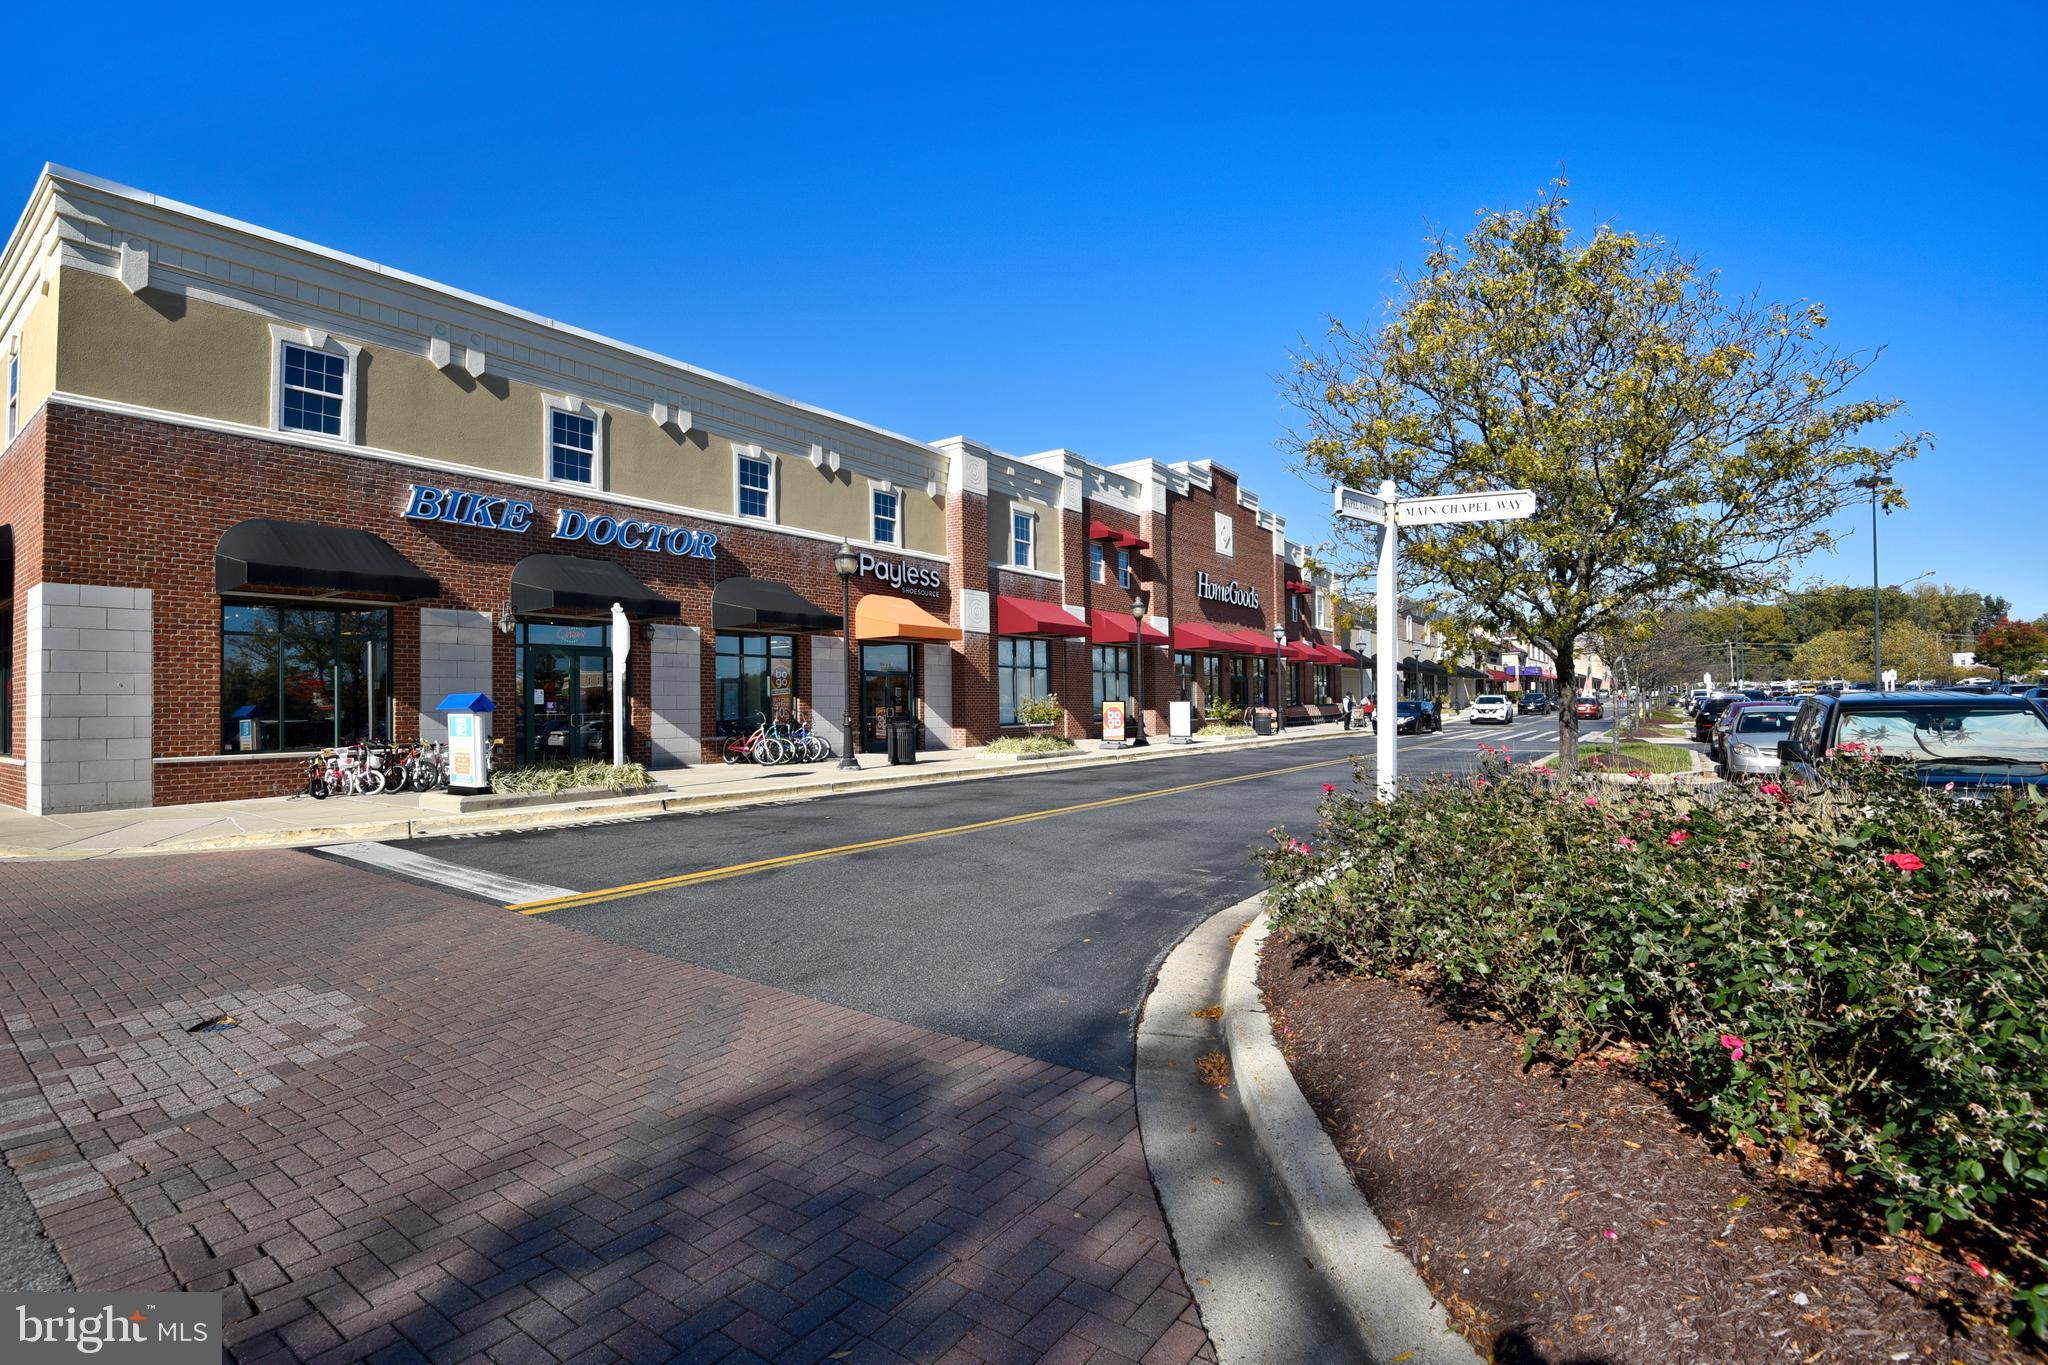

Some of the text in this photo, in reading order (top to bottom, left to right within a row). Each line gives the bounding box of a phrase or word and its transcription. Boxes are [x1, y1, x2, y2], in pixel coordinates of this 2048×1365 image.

[1405, 499, 1522, 516] MAIN CHAPEL WAY
[400, 484, 718, 560] BIKE DOCTOR
[859, 552, 941, 589] Payless
[901, 587, 940, 598] SHOESOURCE
[1197, 570, 1260, 609] HomeGoods
[775, 670, 788, 679] bo
[775, 679, 788, 688] go
